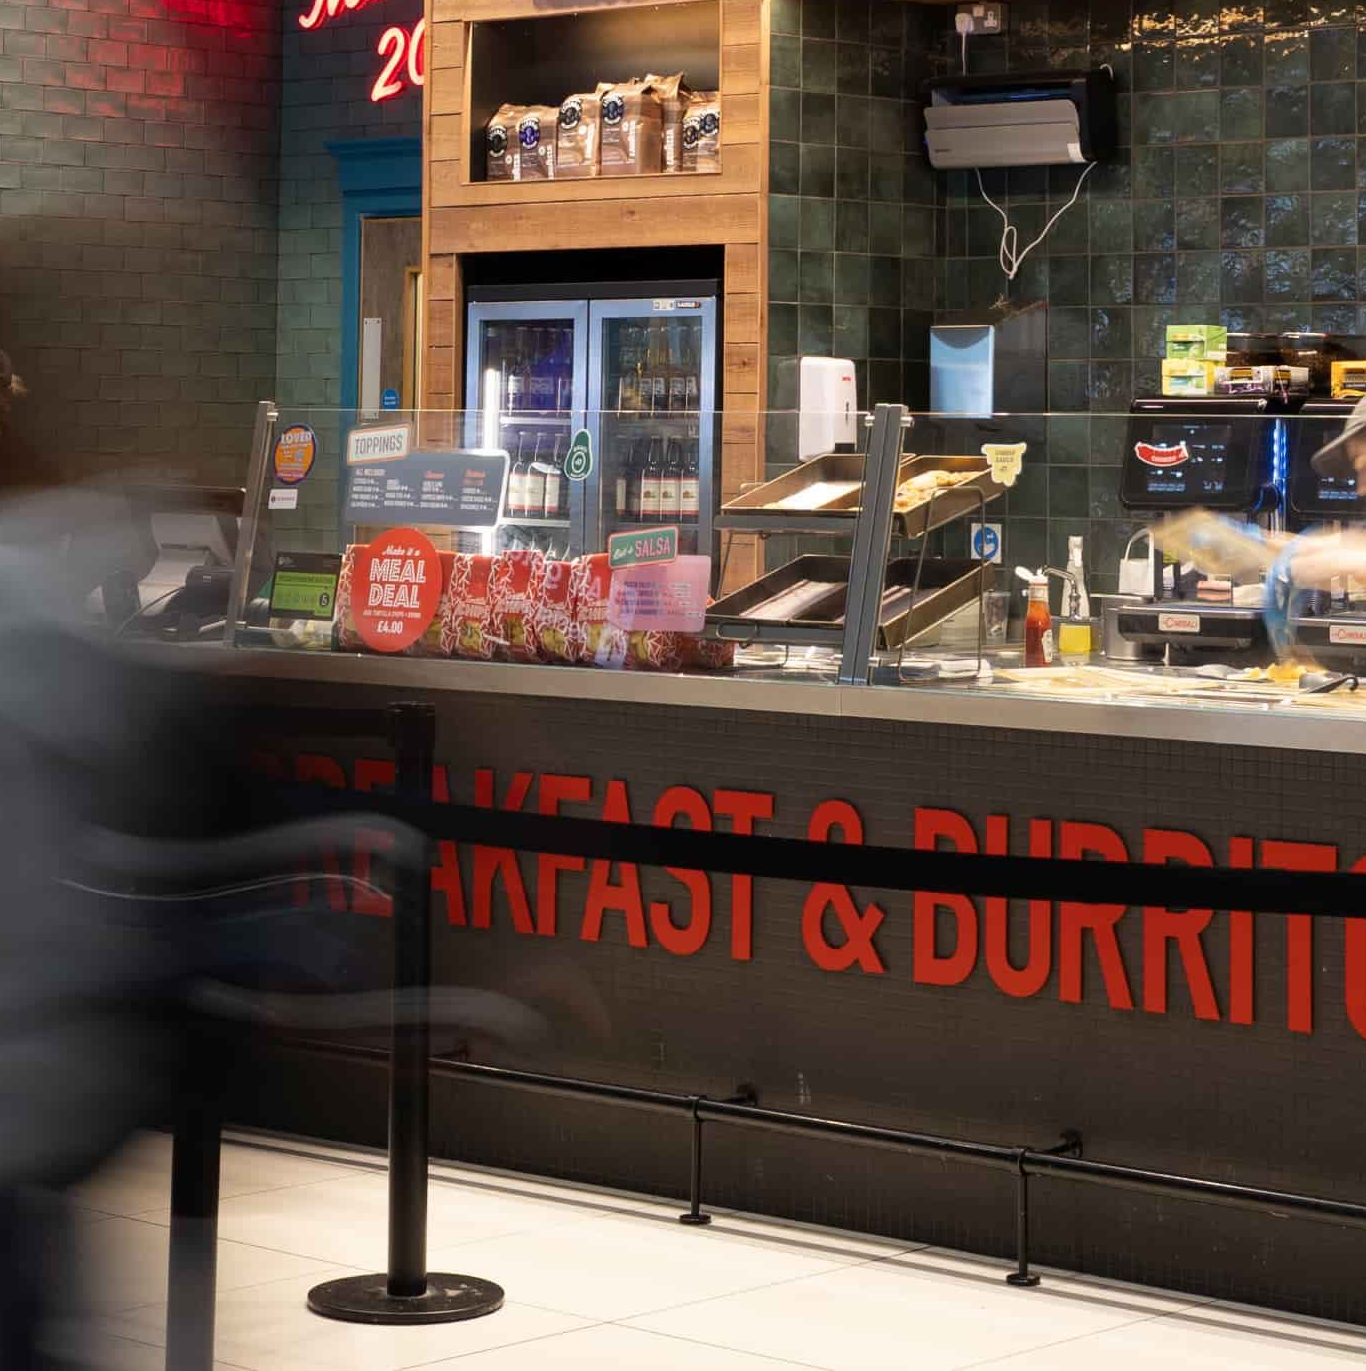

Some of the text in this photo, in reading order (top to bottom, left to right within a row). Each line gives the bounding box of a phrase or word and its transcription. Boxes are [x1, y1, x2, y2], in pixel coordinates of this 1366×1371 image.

[355, 434, 404, 455] TOPPINGS
[635, 534, 671, 557] SALSA
[369, 558, 427, 583] MEAL
[368, 584, 420, 609] DEAL
[377, 620, 403, 634] £4.00
[802, 800, 885, 974] &
